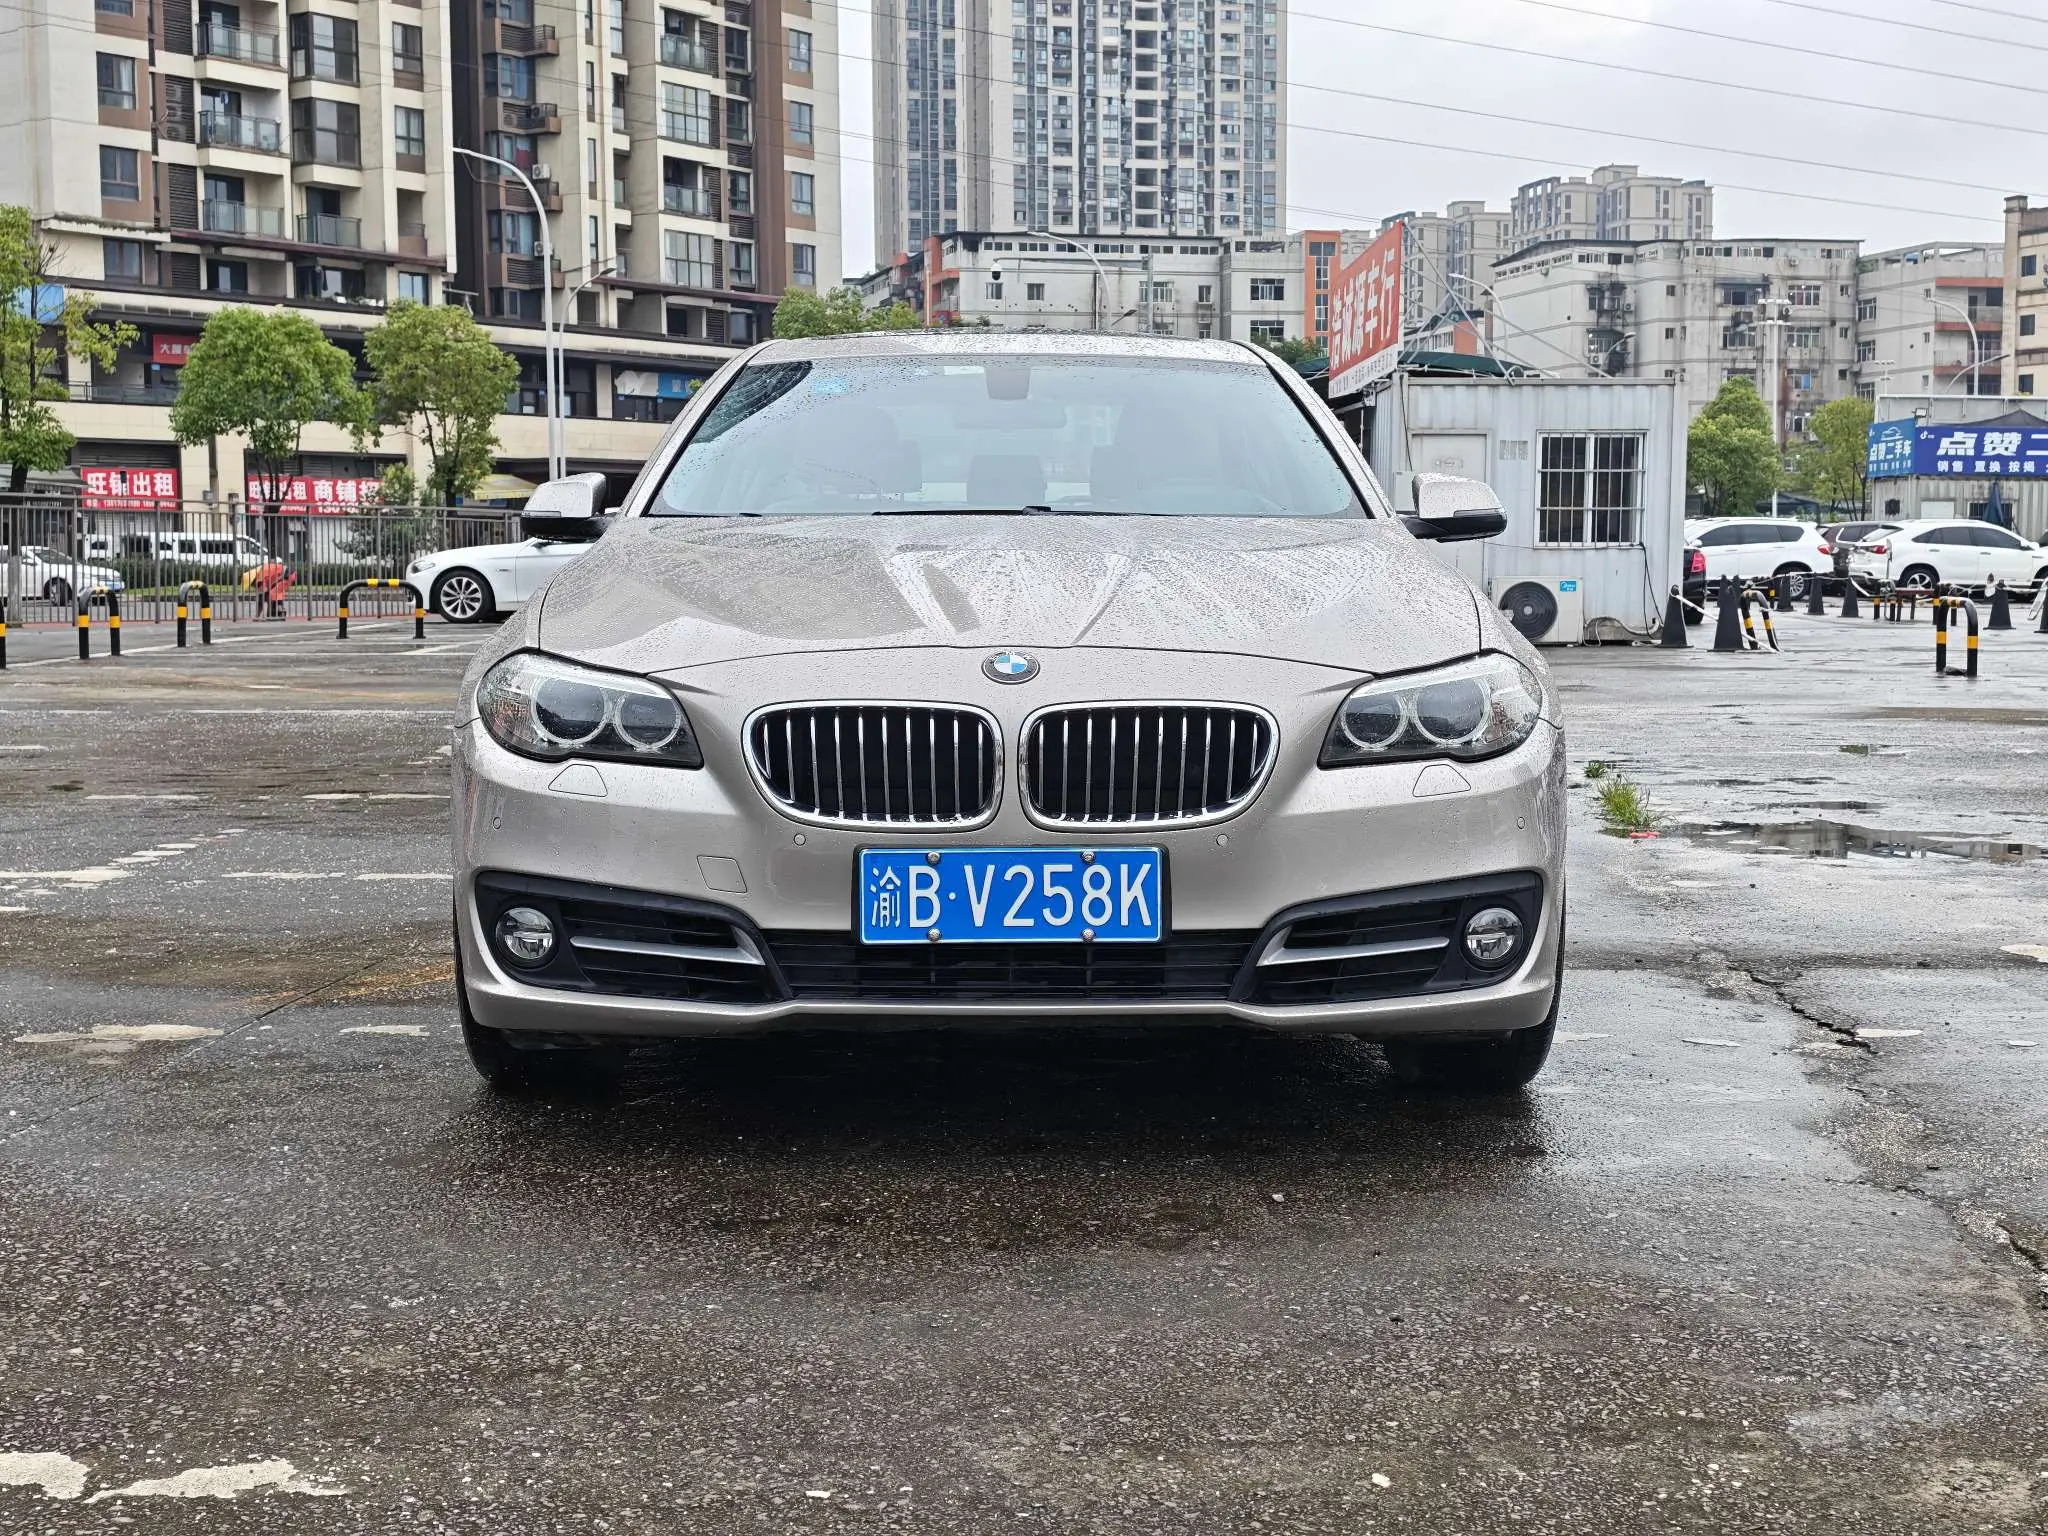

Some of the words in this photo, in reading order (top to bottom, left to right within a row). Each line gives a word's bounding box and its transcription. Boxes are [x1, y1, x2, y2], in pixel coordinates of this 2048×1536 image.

[1937, 461, 1963, 472] 销售
[1975, 461, 2000, 472] 置换
[2008, 461, 2035, 472] 按揭
